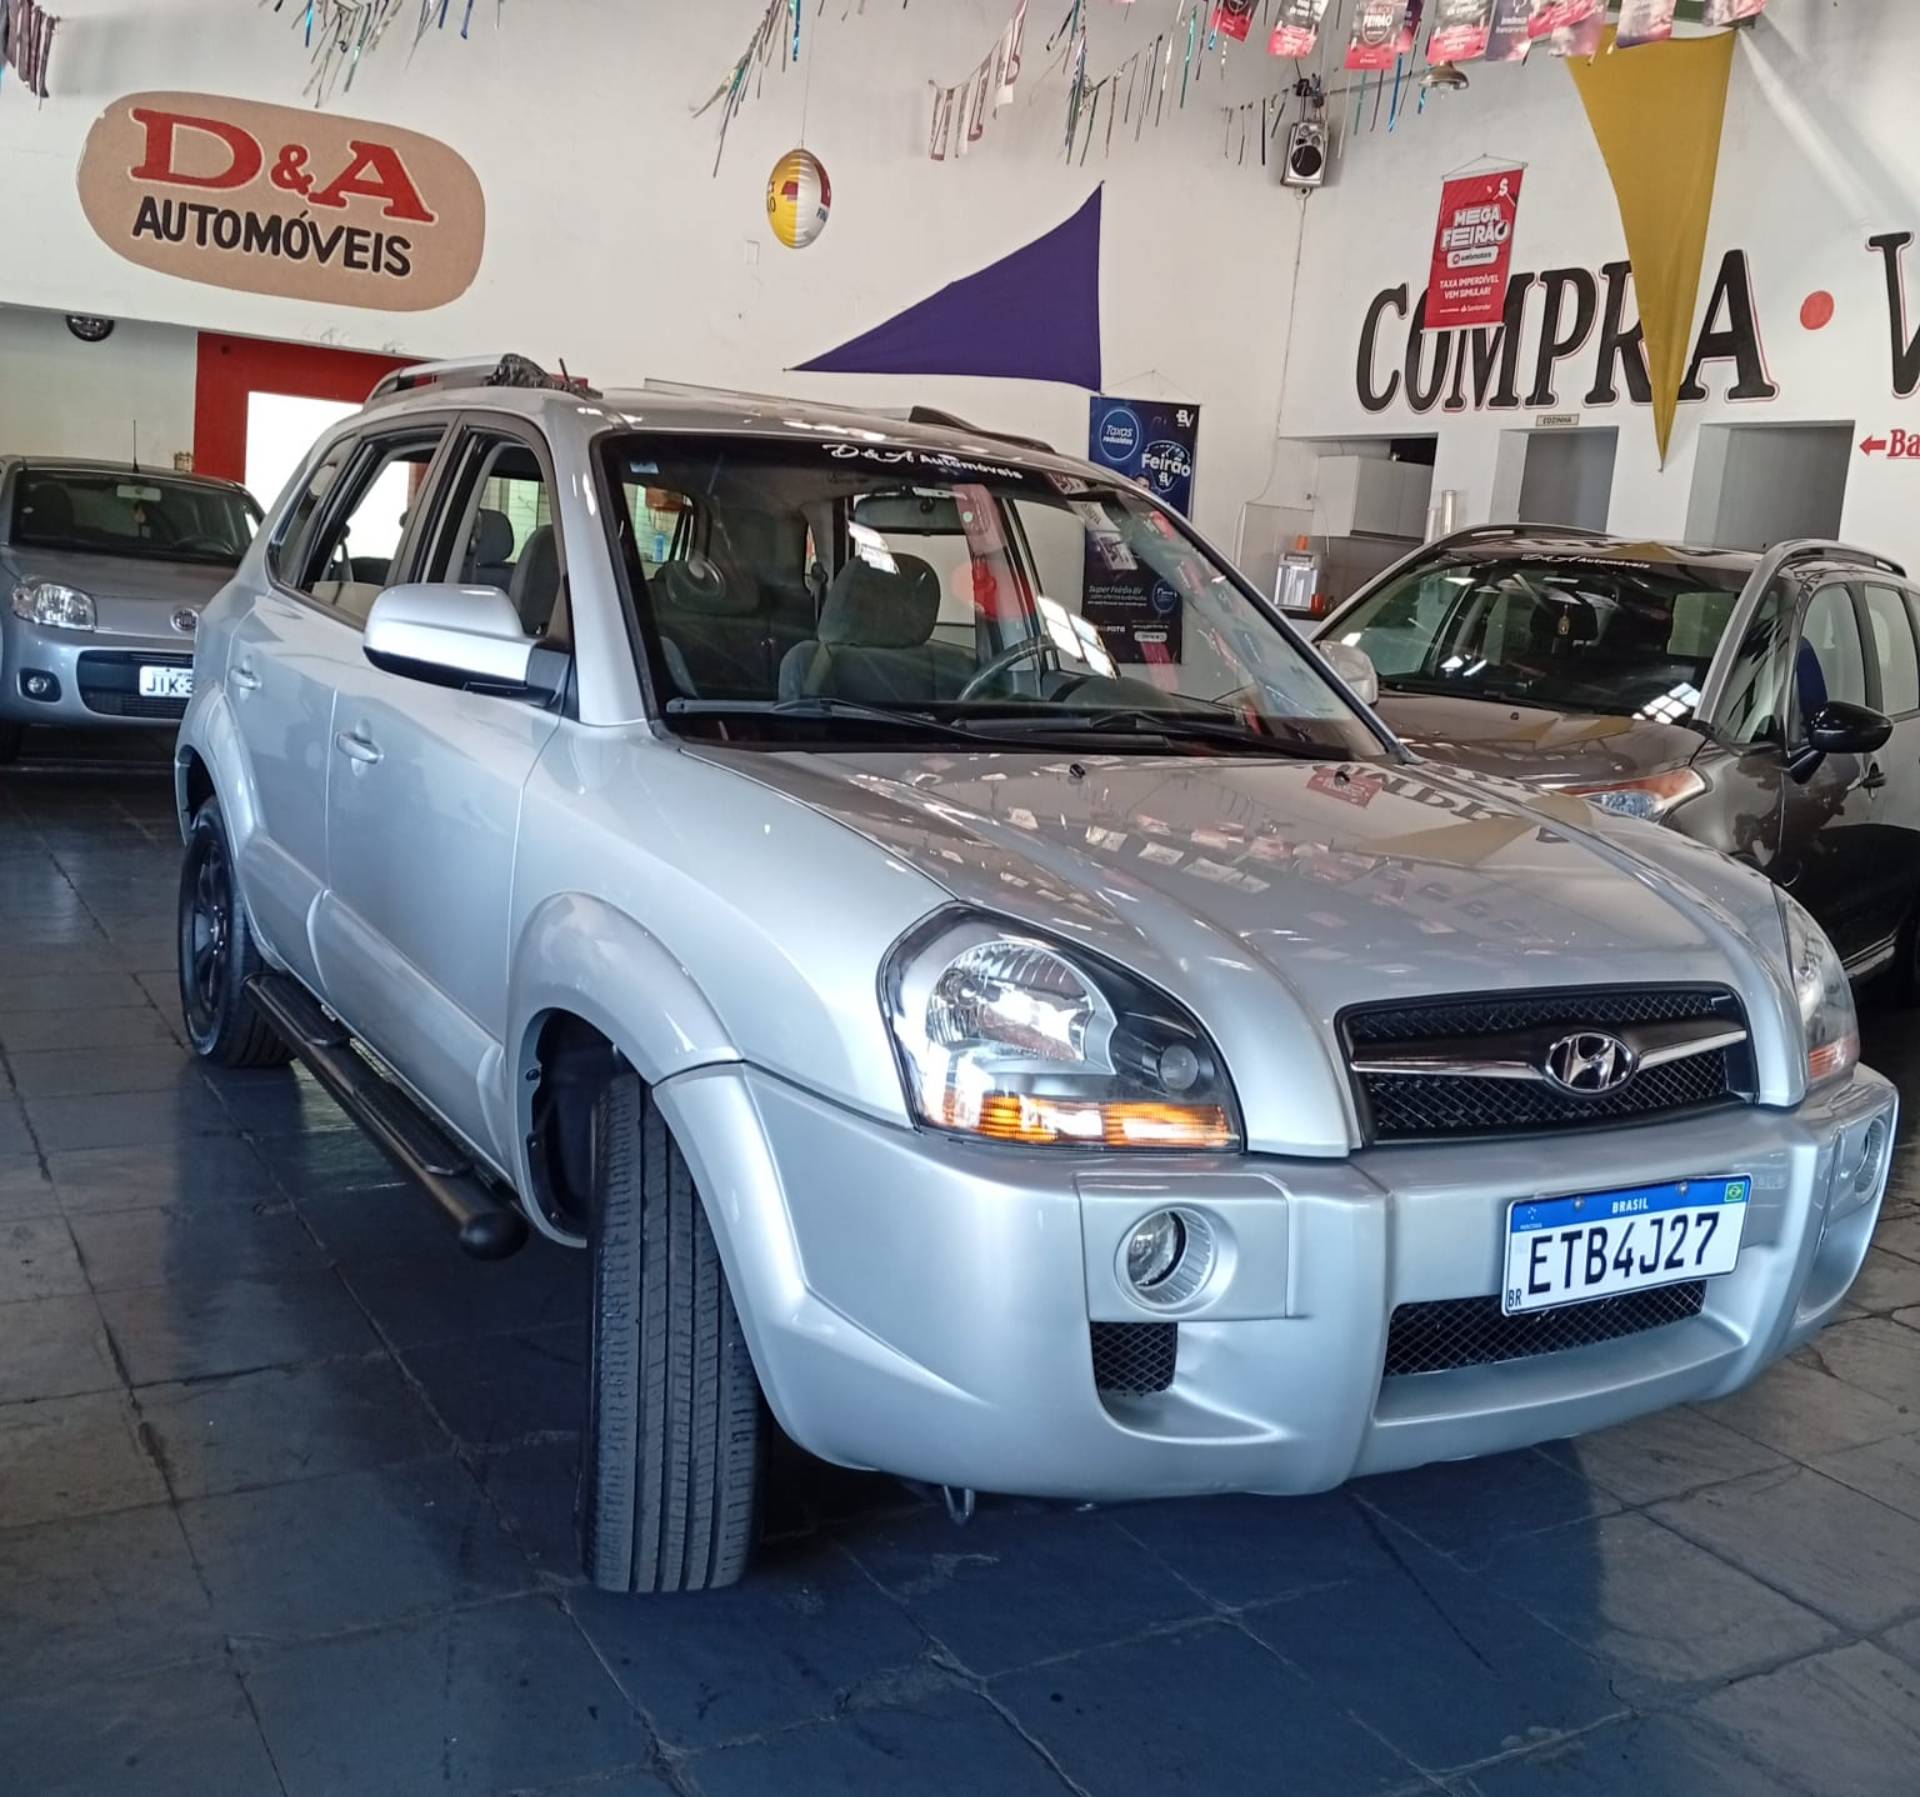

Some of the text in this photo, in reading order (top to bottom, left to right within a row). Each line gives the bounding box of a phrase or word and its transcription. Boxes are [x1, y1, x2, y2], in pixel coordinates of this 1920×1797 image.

[130, 107, 435, 222] D&A
[1454, 205, 1501, 227] MEGA
[132, 196, 412, 277] AUTOMÓVEIS
[1441, 219, 1510, 250] FEIRÃO
[1440, 278, 1458, 289] TAXA
[1444, 289, 1460, 299] VEM
[1106, 424, 1133, 437] Taxas
[1141, 453, 1191, 477] Feirão
[1612, 1197, 1648, 1214] BRASIL
[1528, 1211, 1720, 1296] ETB4J27
[1508, 1288, 1522, 1307] BR
